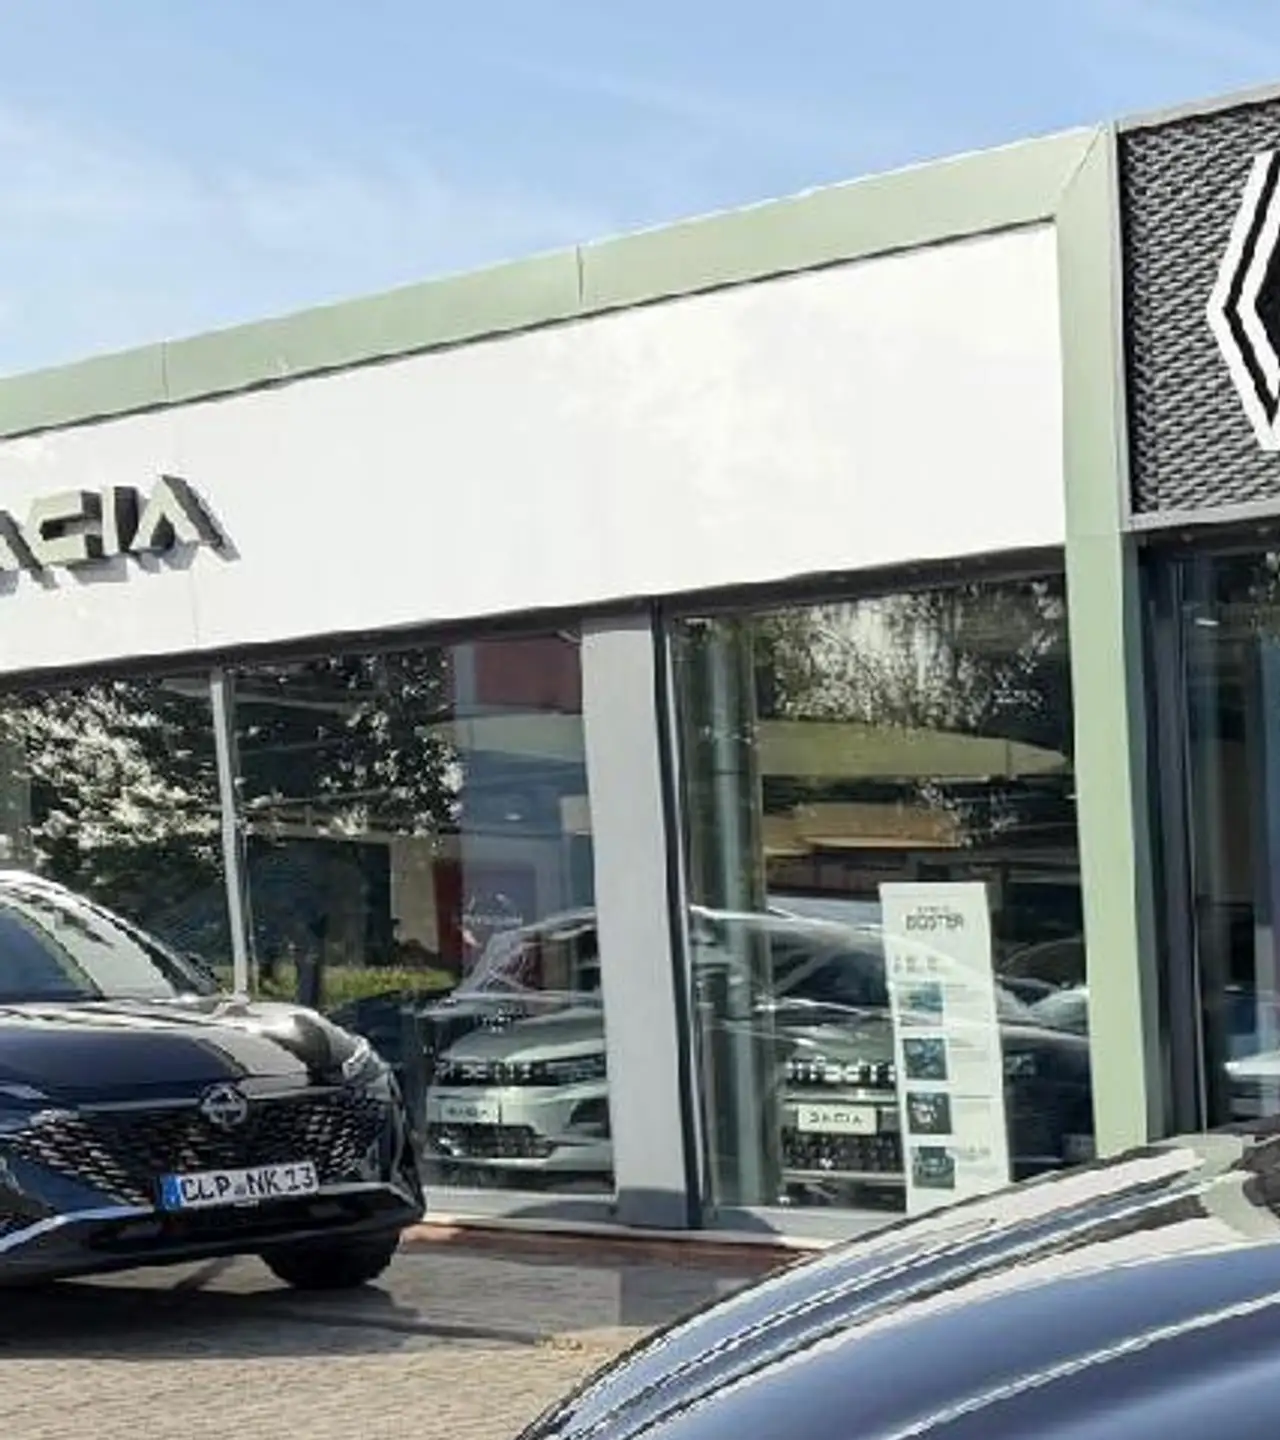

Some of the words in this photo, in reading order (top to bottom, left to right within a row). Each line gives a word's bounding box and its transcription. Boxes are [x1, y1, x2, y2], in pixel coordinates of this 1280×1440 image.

[181, 1176, 230, 1201] CLP
[246, 1170, 280, 1195] NK
[284, 1166, 315, 1191] 13
